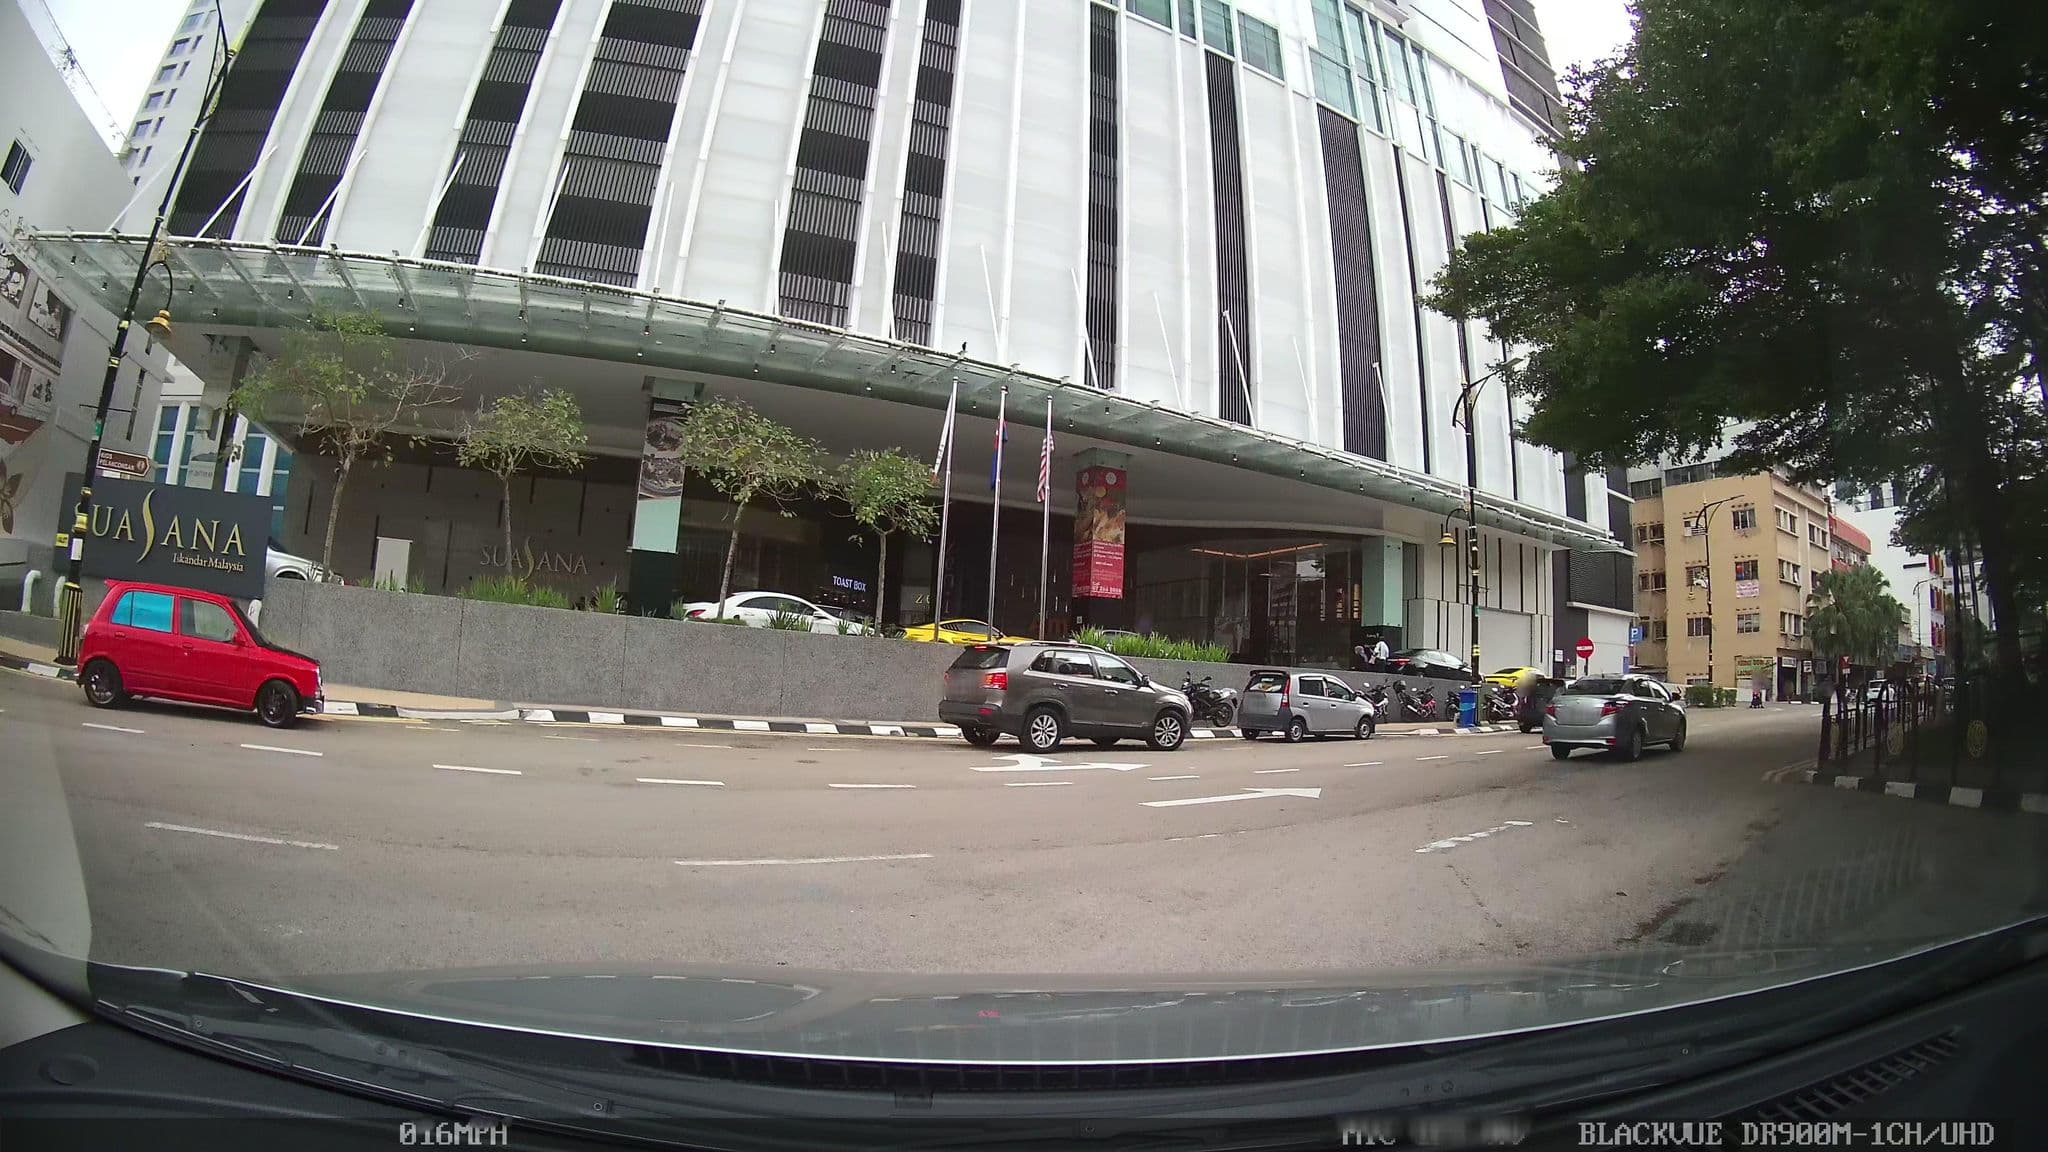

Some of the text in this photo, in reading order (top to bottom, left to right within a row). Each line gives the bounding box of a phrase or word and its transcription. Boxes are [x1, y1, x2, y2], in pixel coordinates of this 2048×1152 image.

[173, 552, 245, 573] Iskandar Malaysia
[832, 575, 867, 592] TOAST BOX
[1631, 627, 1639, 639] P
